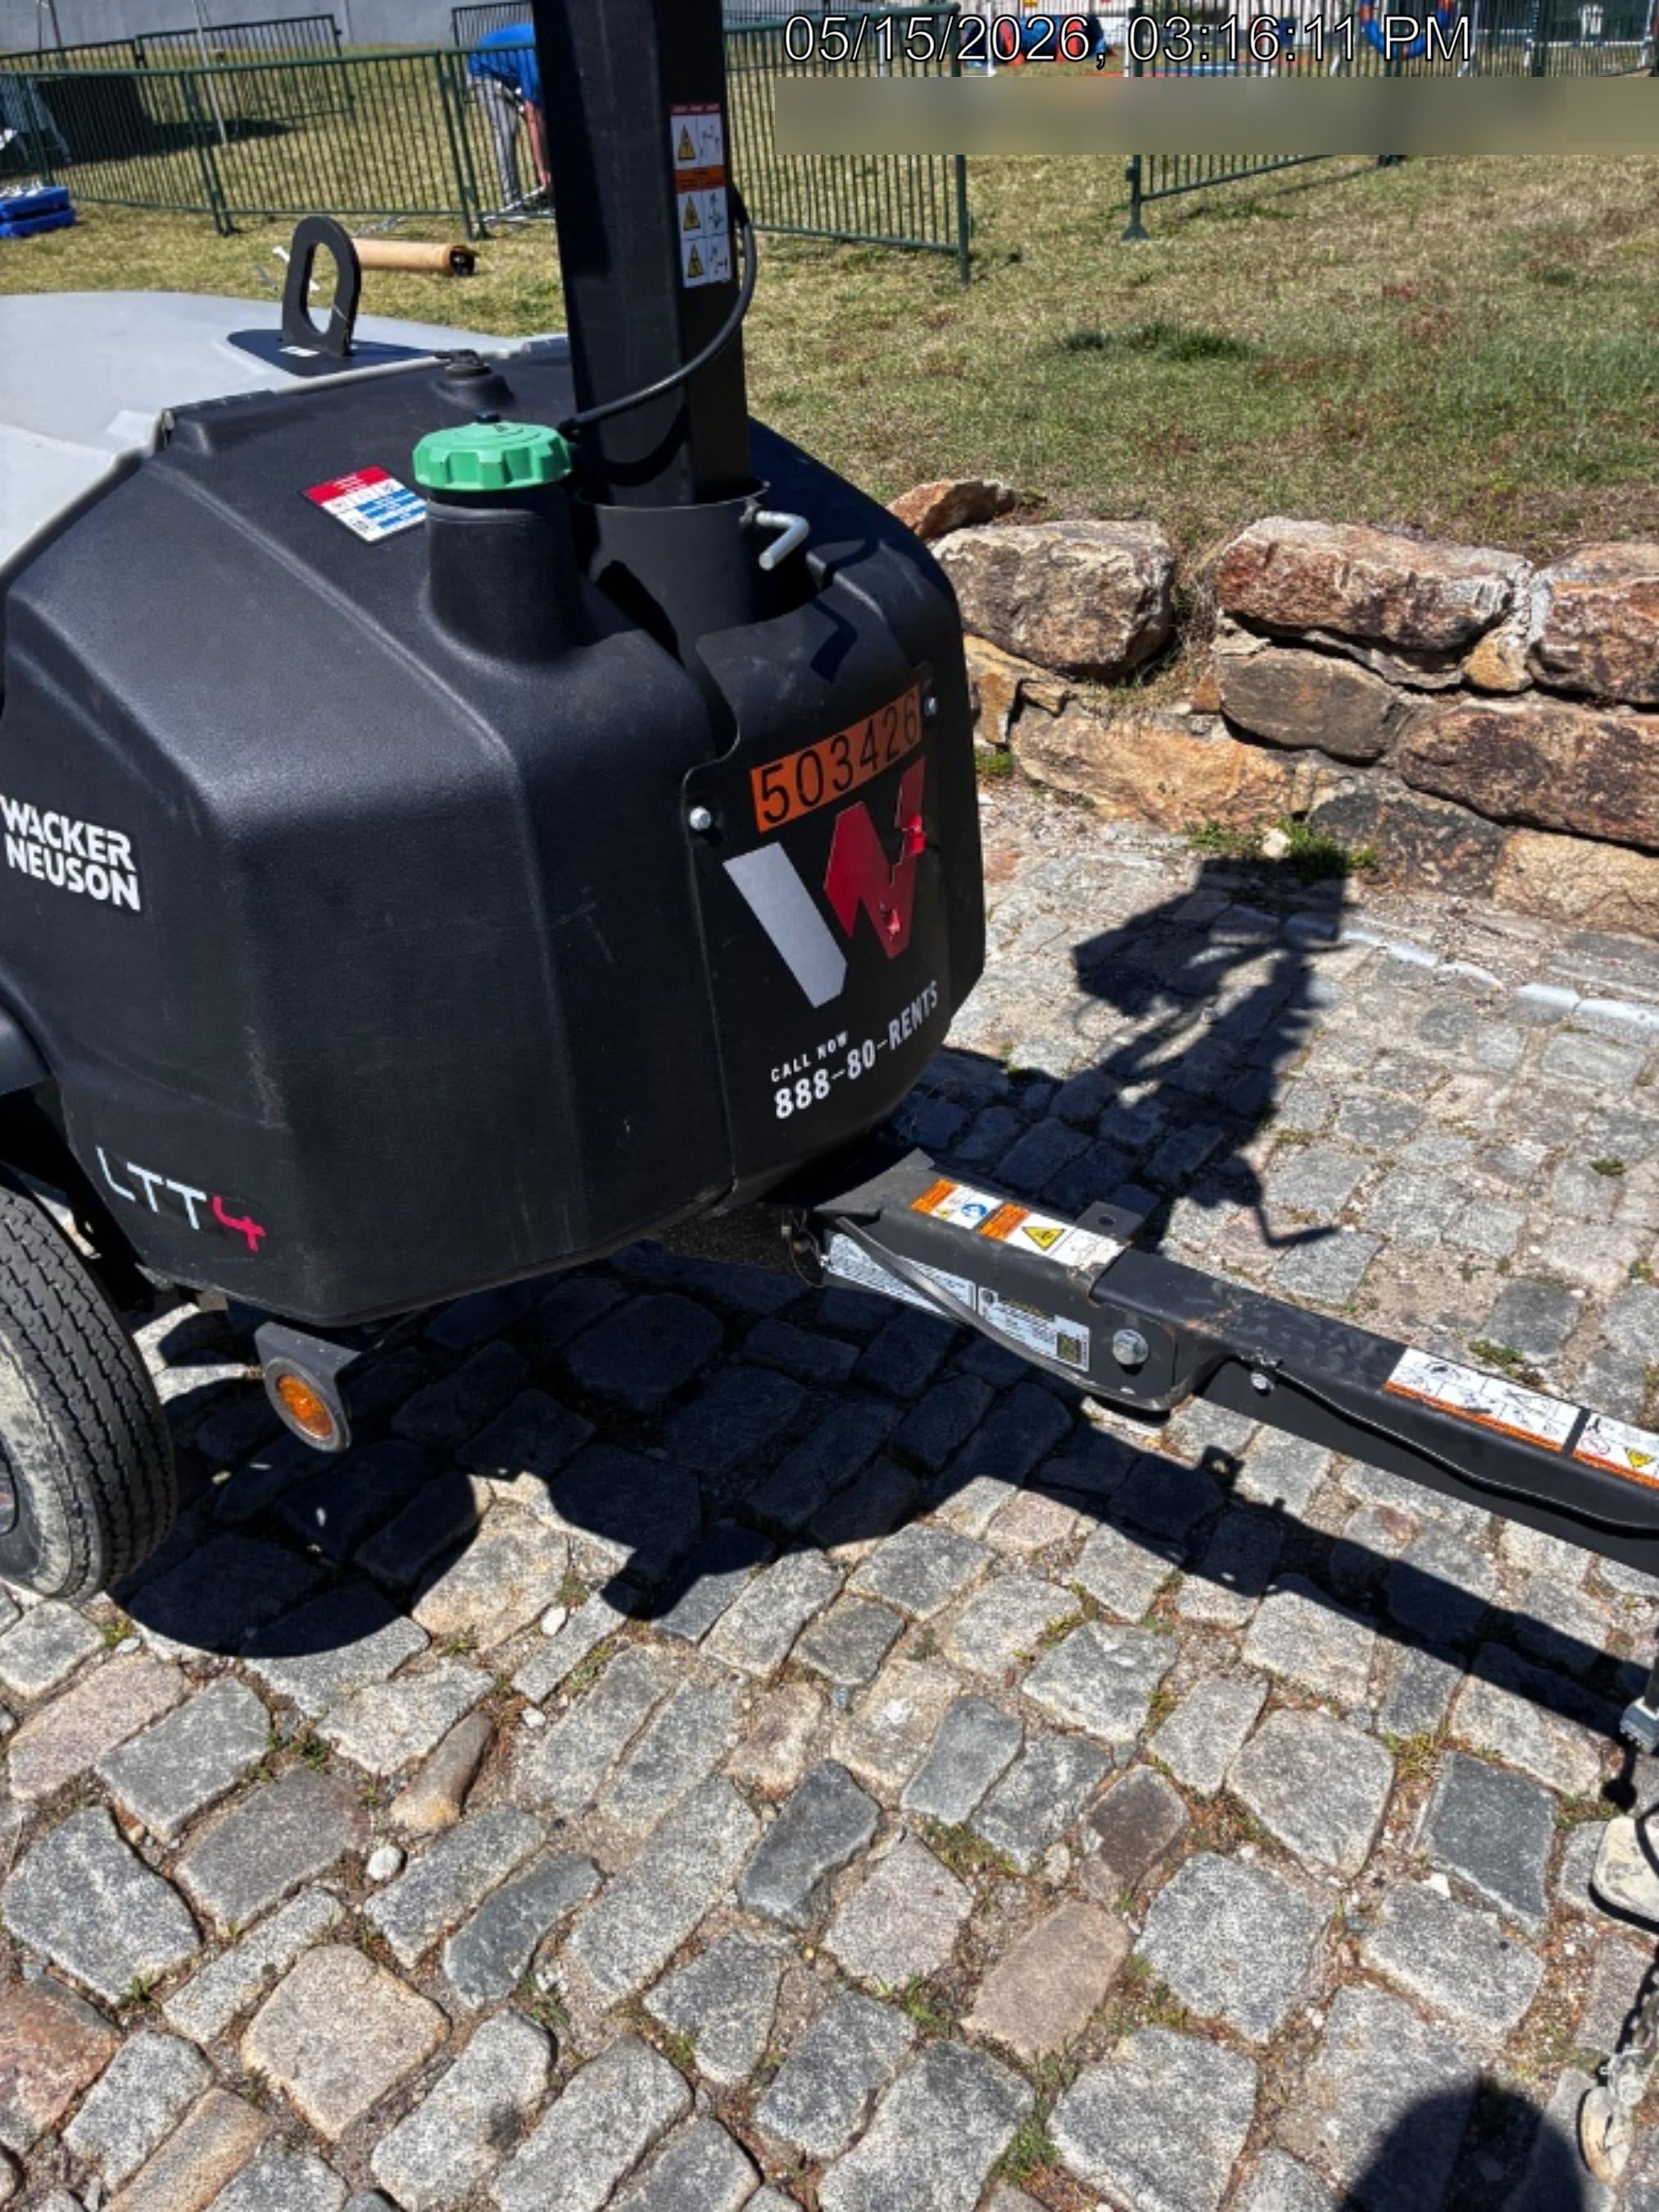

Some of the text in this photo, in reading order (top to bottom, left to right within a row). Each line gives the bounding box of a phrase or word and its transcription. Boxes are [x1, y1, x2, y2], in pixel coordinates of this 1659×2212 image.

[759, 692, 919, 823] 503426
[0, 793, 137, 873] WACKER
[5, 832, 141, 912] NEUSON
[771, 1030, 848, 1082] CALL NOW
[774, 980, 937, 1118] 888-80-RENTS
